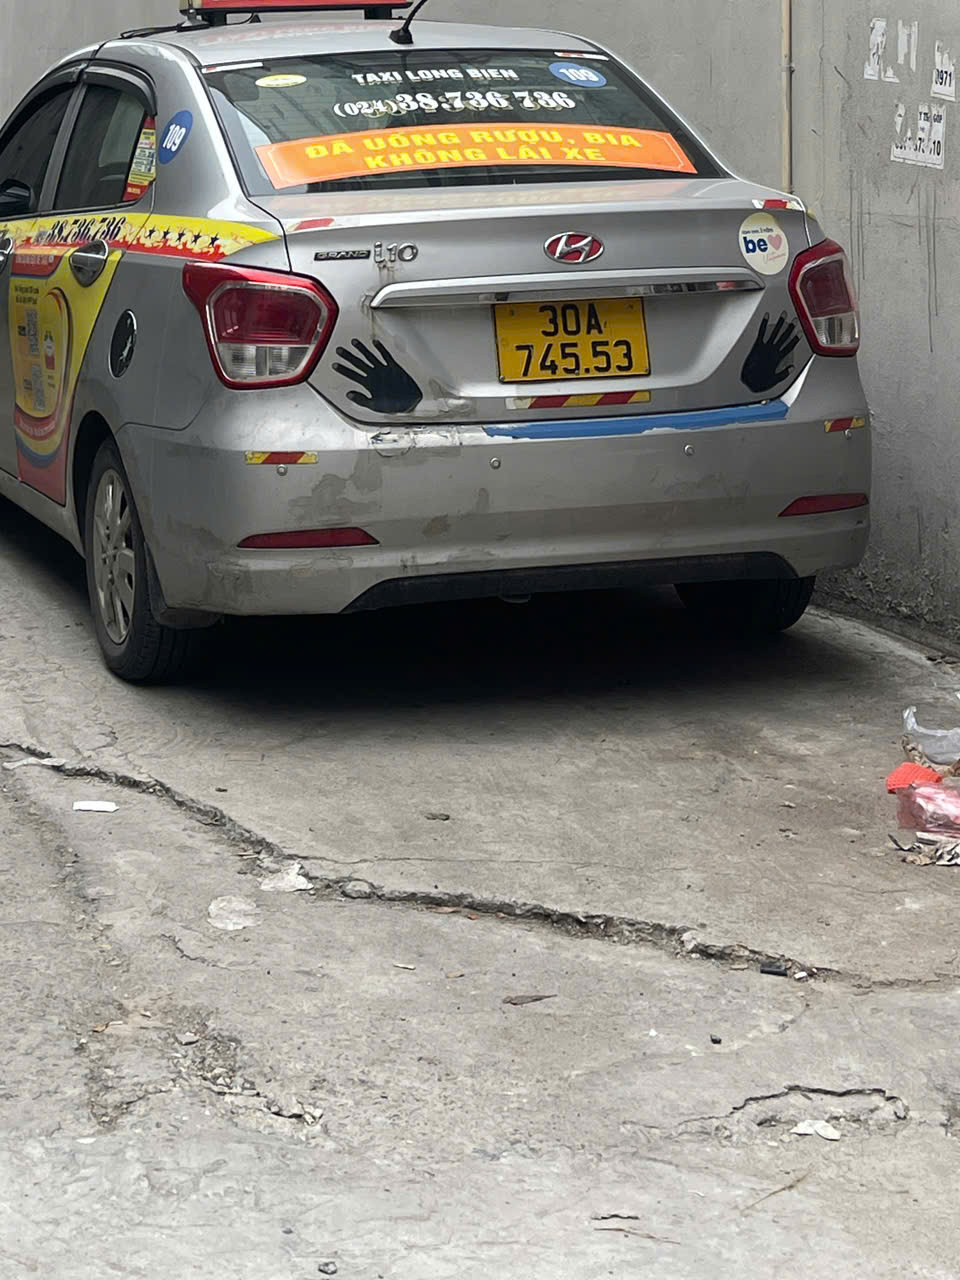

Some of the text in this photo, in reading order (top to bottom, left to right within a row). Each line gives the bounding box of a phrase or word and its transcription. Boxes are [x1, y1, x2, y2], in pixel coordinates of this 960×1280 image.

[351, 72, 403, 85] TAXI
[405, 69, 464, 81] LONG
[558, 68, 600, 82] 109
[162, 123, 187, 152] 109
[583, 132, 643, 147] BIA
[363, 147, 489, 170] KHÔNG
[560, 147, 607, 161] XE
[742, 235, 769, 254] be
[315, 250, 371, 261] GRAND
[538, 302, 604, 337] 30A
[515, 339, 634, 377] 745.53
